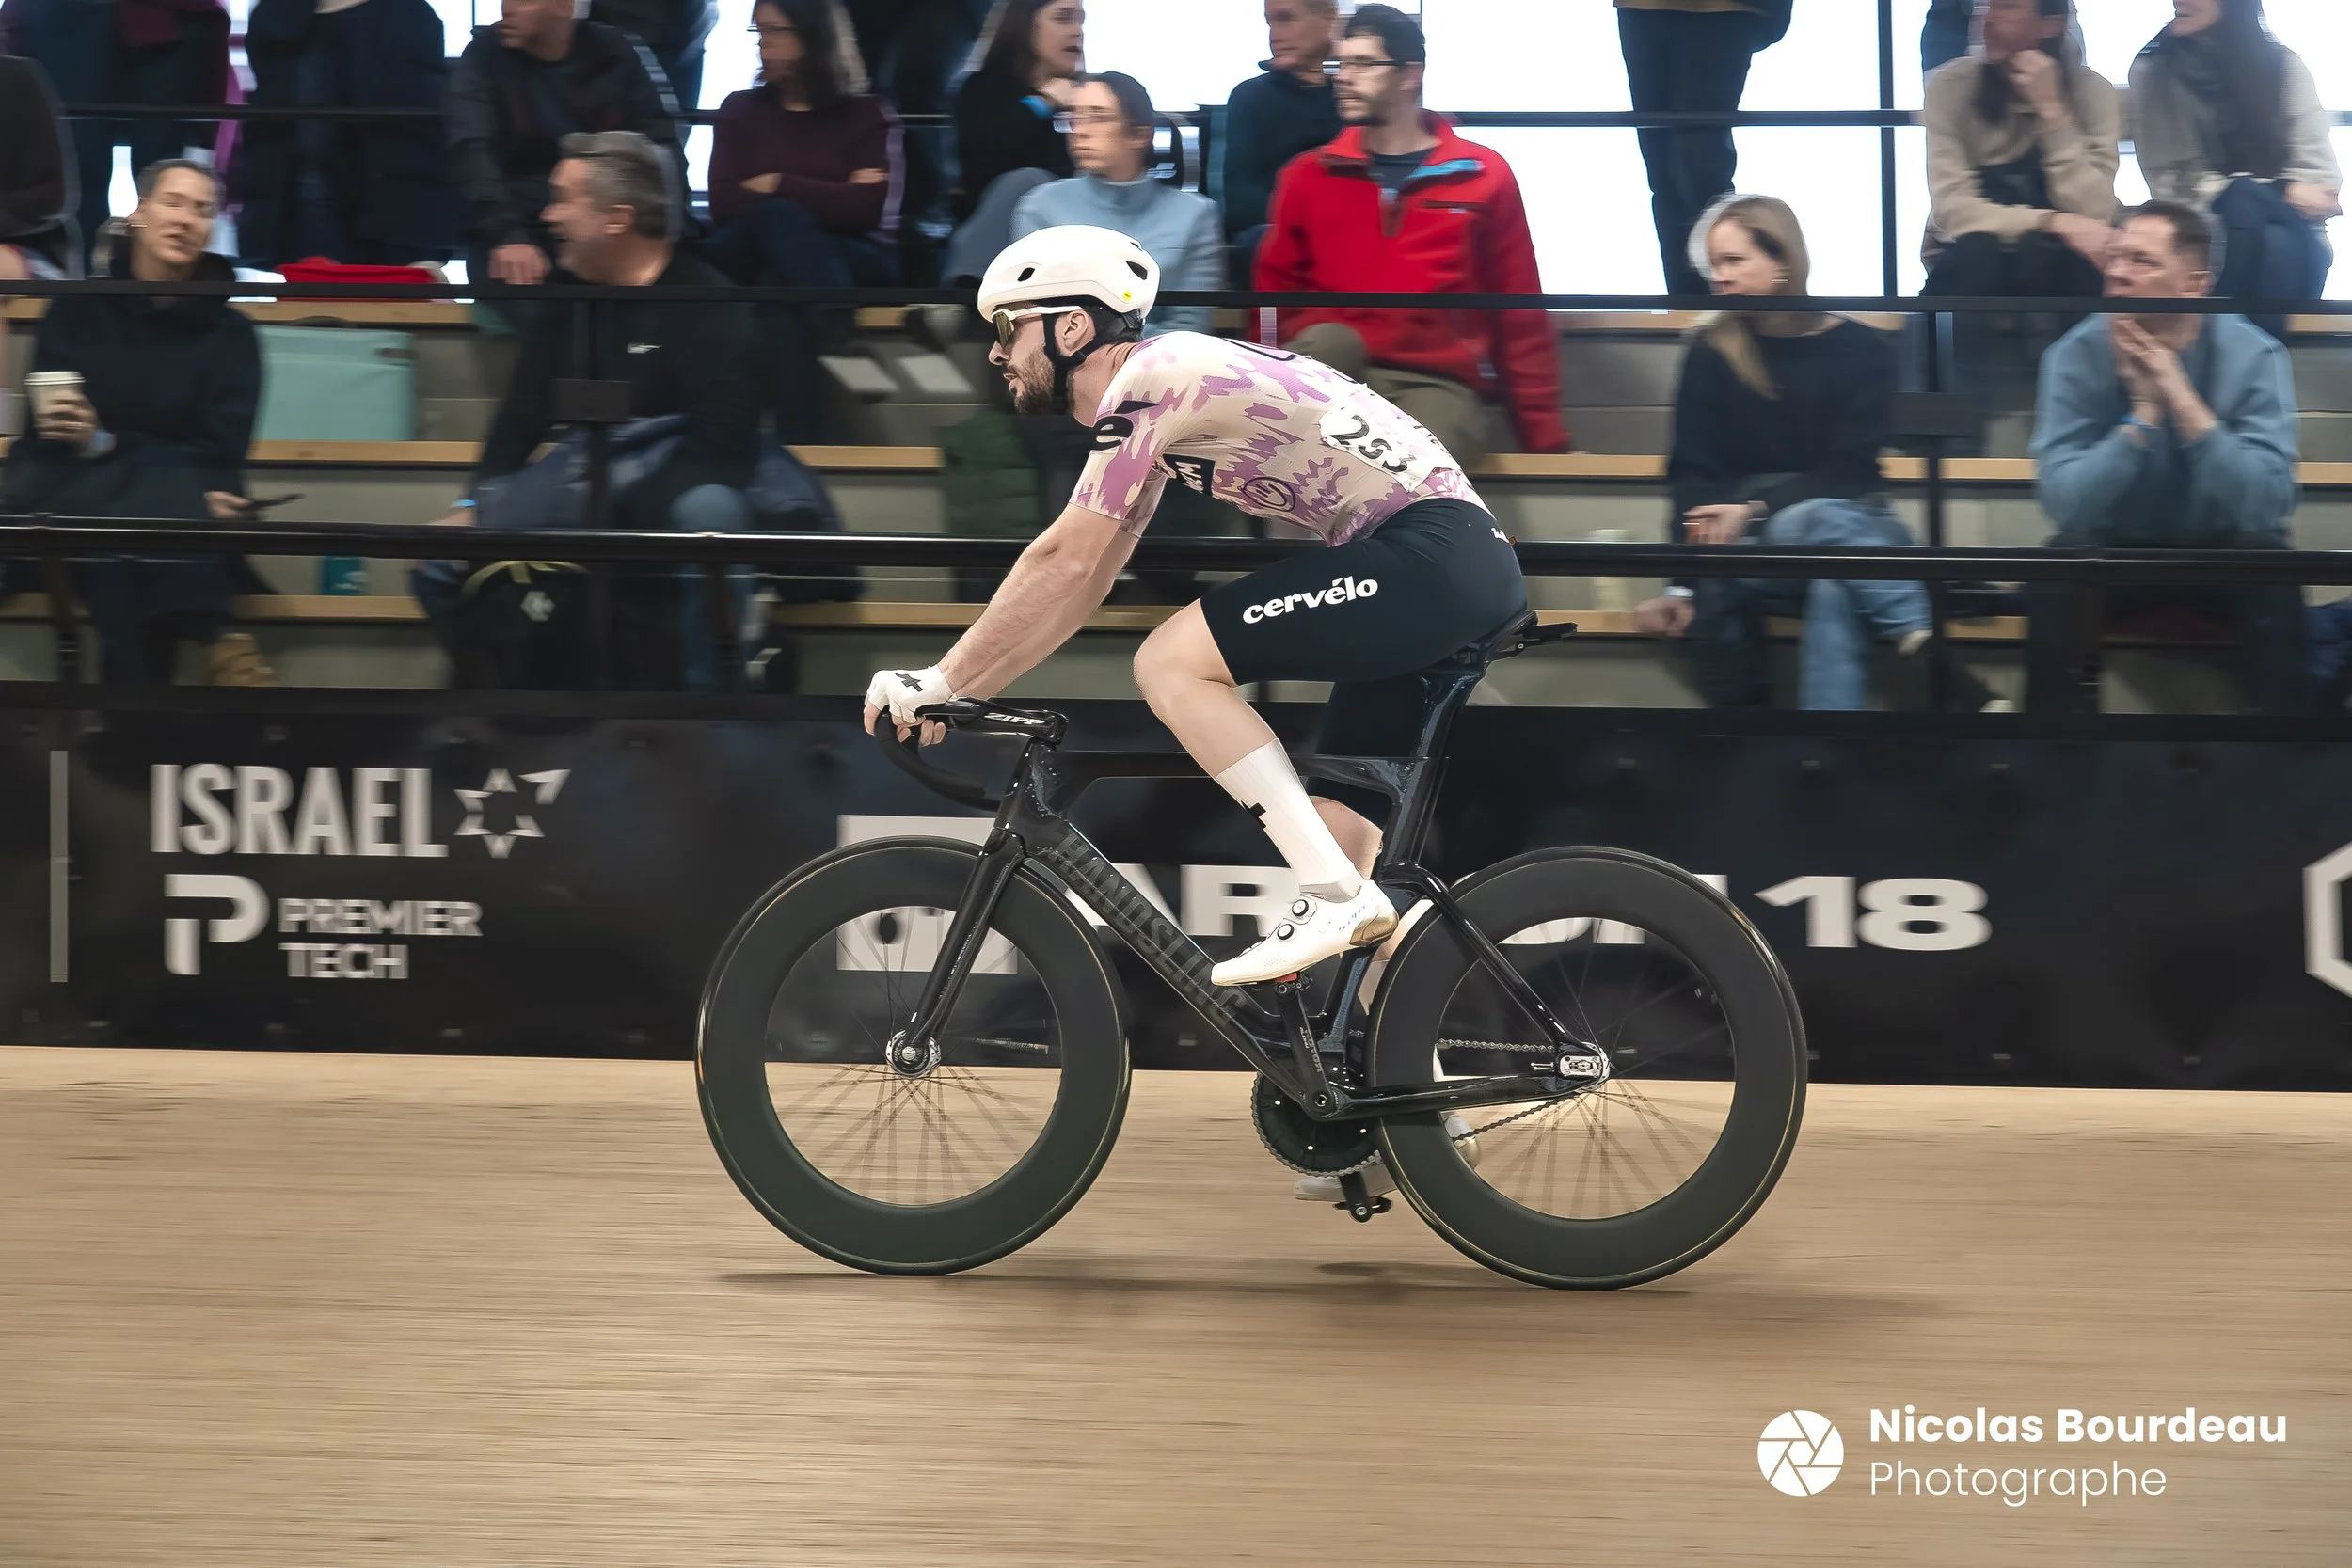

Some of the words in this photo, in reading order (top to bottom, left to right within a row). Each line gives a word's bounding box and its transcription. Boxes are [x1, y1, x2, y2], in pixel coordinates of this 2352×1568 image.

[1329, 414, 1416, 472] 253
[1242, 575, 1378, 625] cervélo
[984, 712, 1045, 725] ZIPP
[149, 763, 449, 857] ISRAEL
[278, 898, 484, 936] PREMIER
[1047, 831, 1247, 1027] HANDSLING
[1752, 876, 1993, 951] 18
[278, 942, 409, 979] TECH
